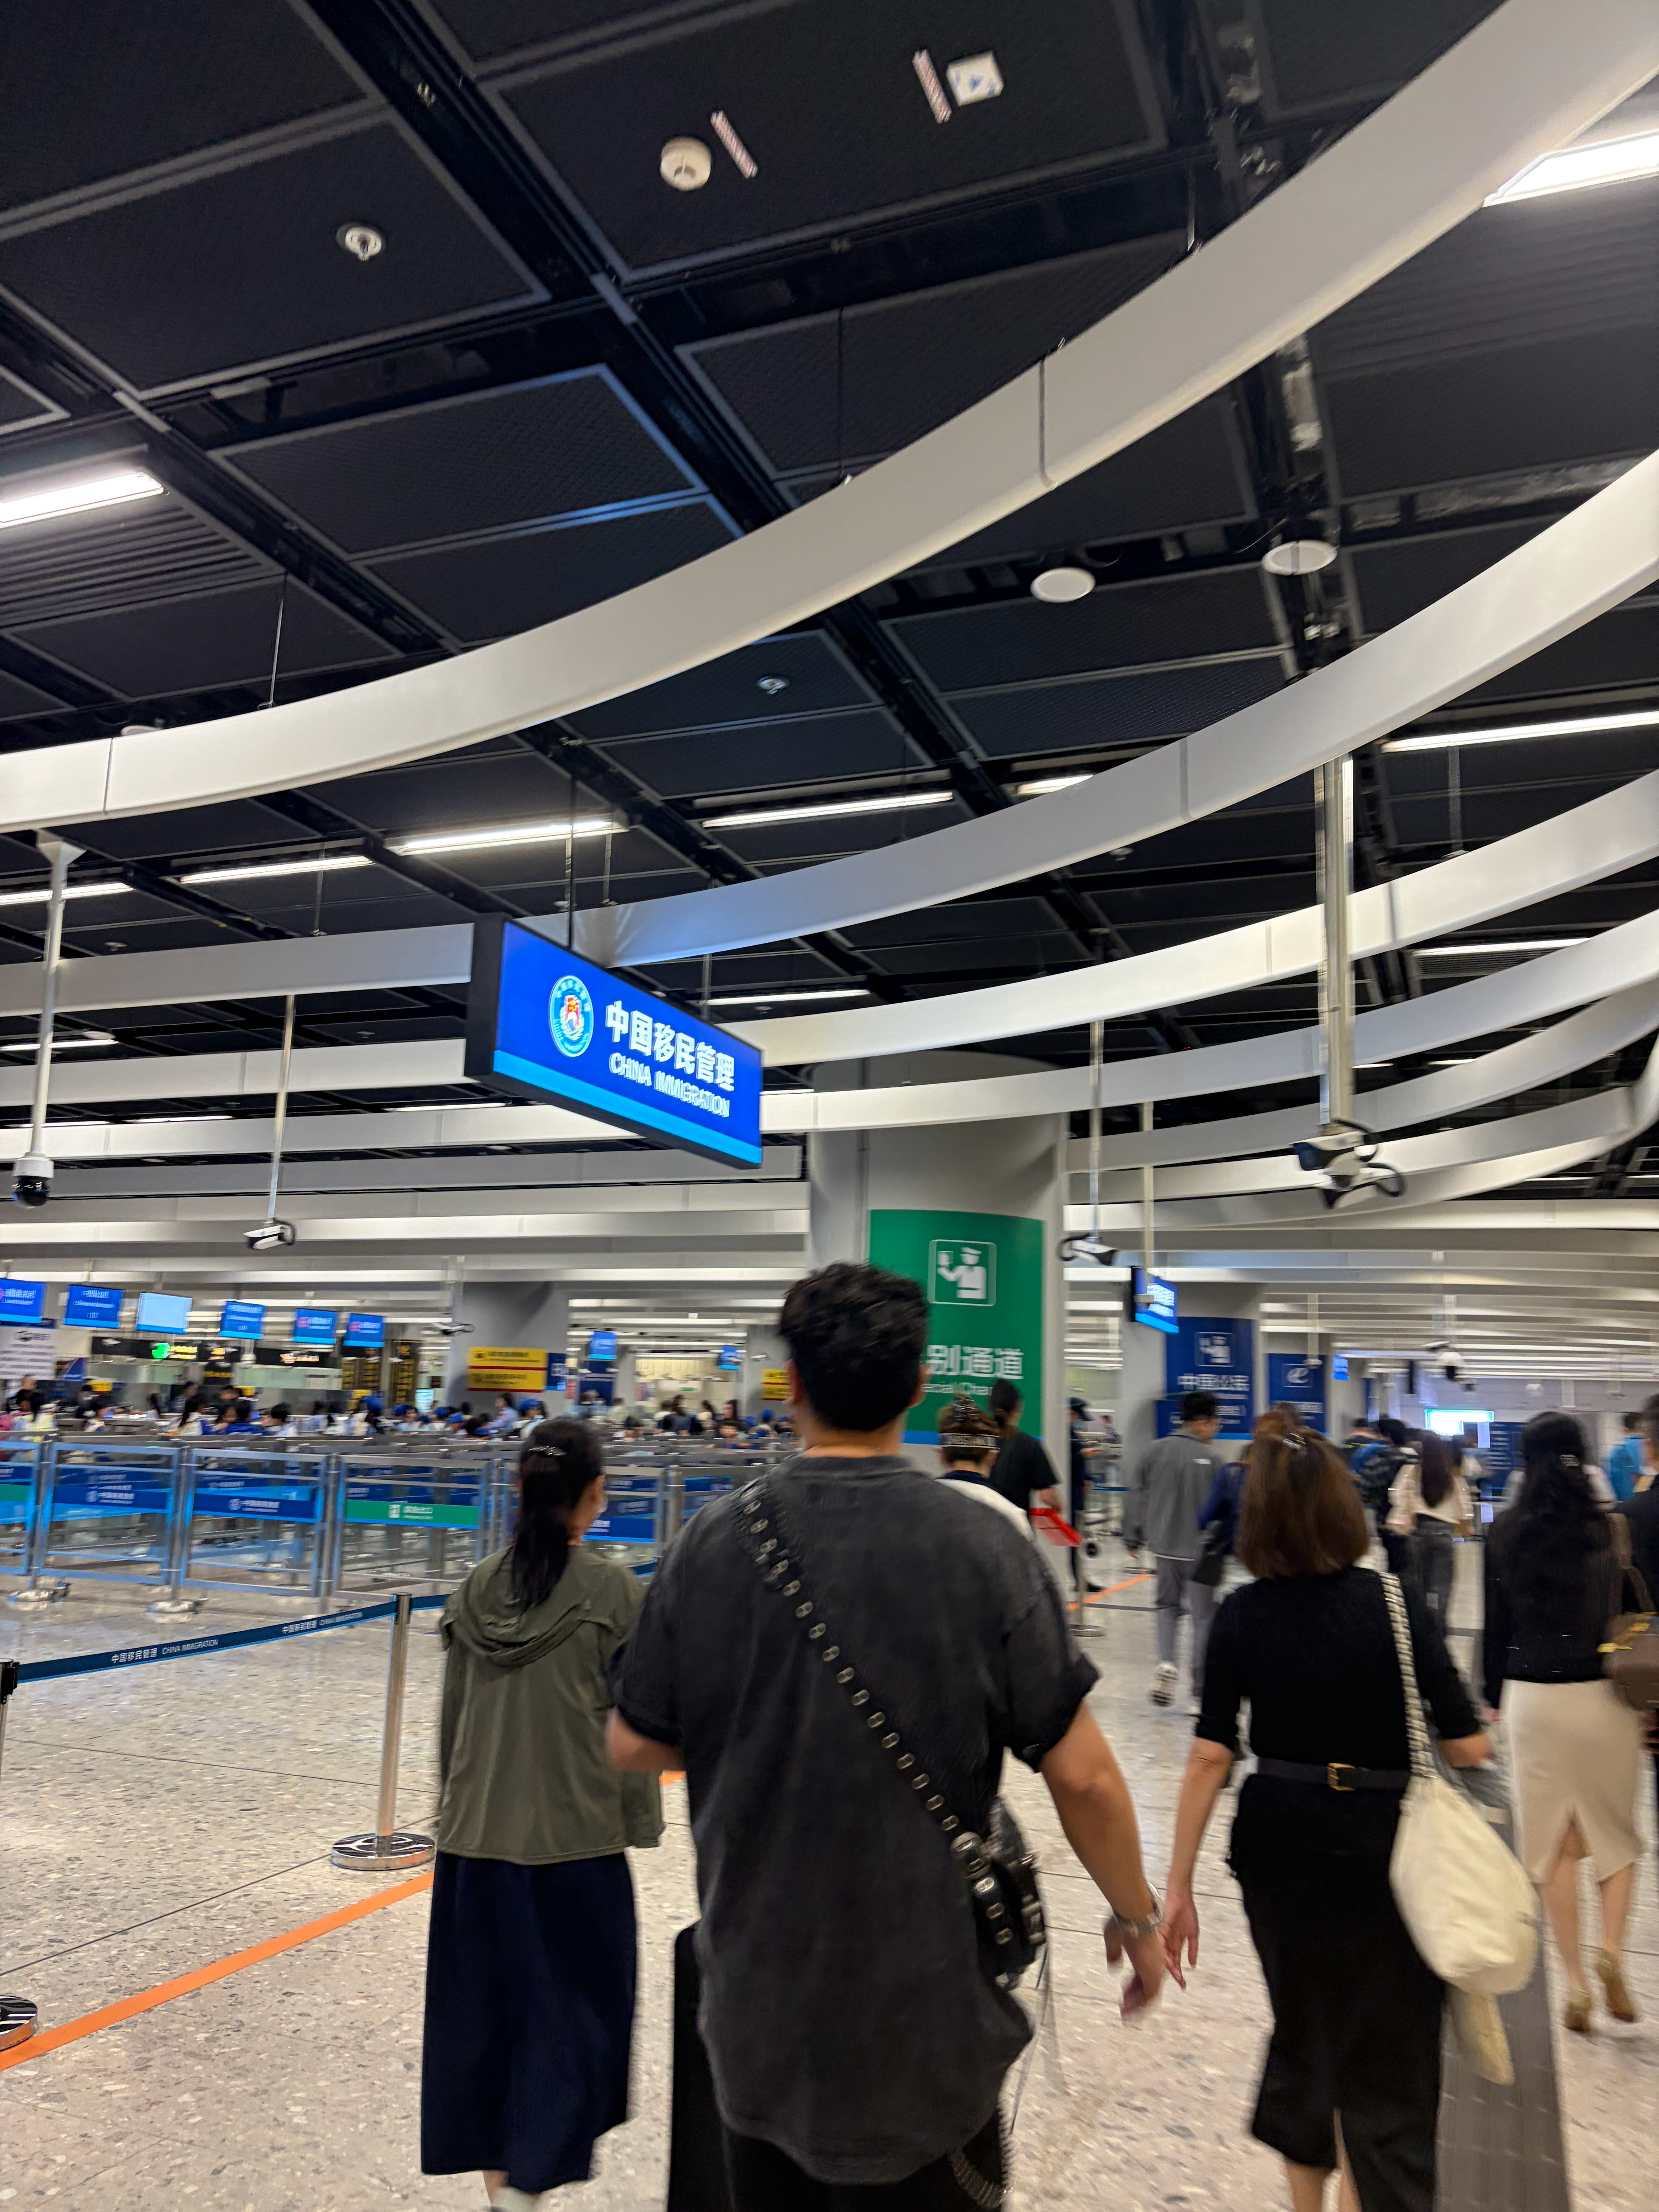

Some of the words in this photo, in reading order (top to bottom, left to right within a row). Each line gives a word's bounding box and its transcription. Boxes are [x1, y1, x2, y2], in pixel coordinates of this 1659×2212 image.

[605, 1000, 734, 1092] 中国移民管理
[609, 1053, 652, 1086] CHINA
[654, 1071, 730, 1118] IMMIGRATION
[925, 1345, 1024, 1379] 别通道
[111, 1648, 158, 1664] 中国移民管理
[161, 1645, 180, 1655] CHINA
